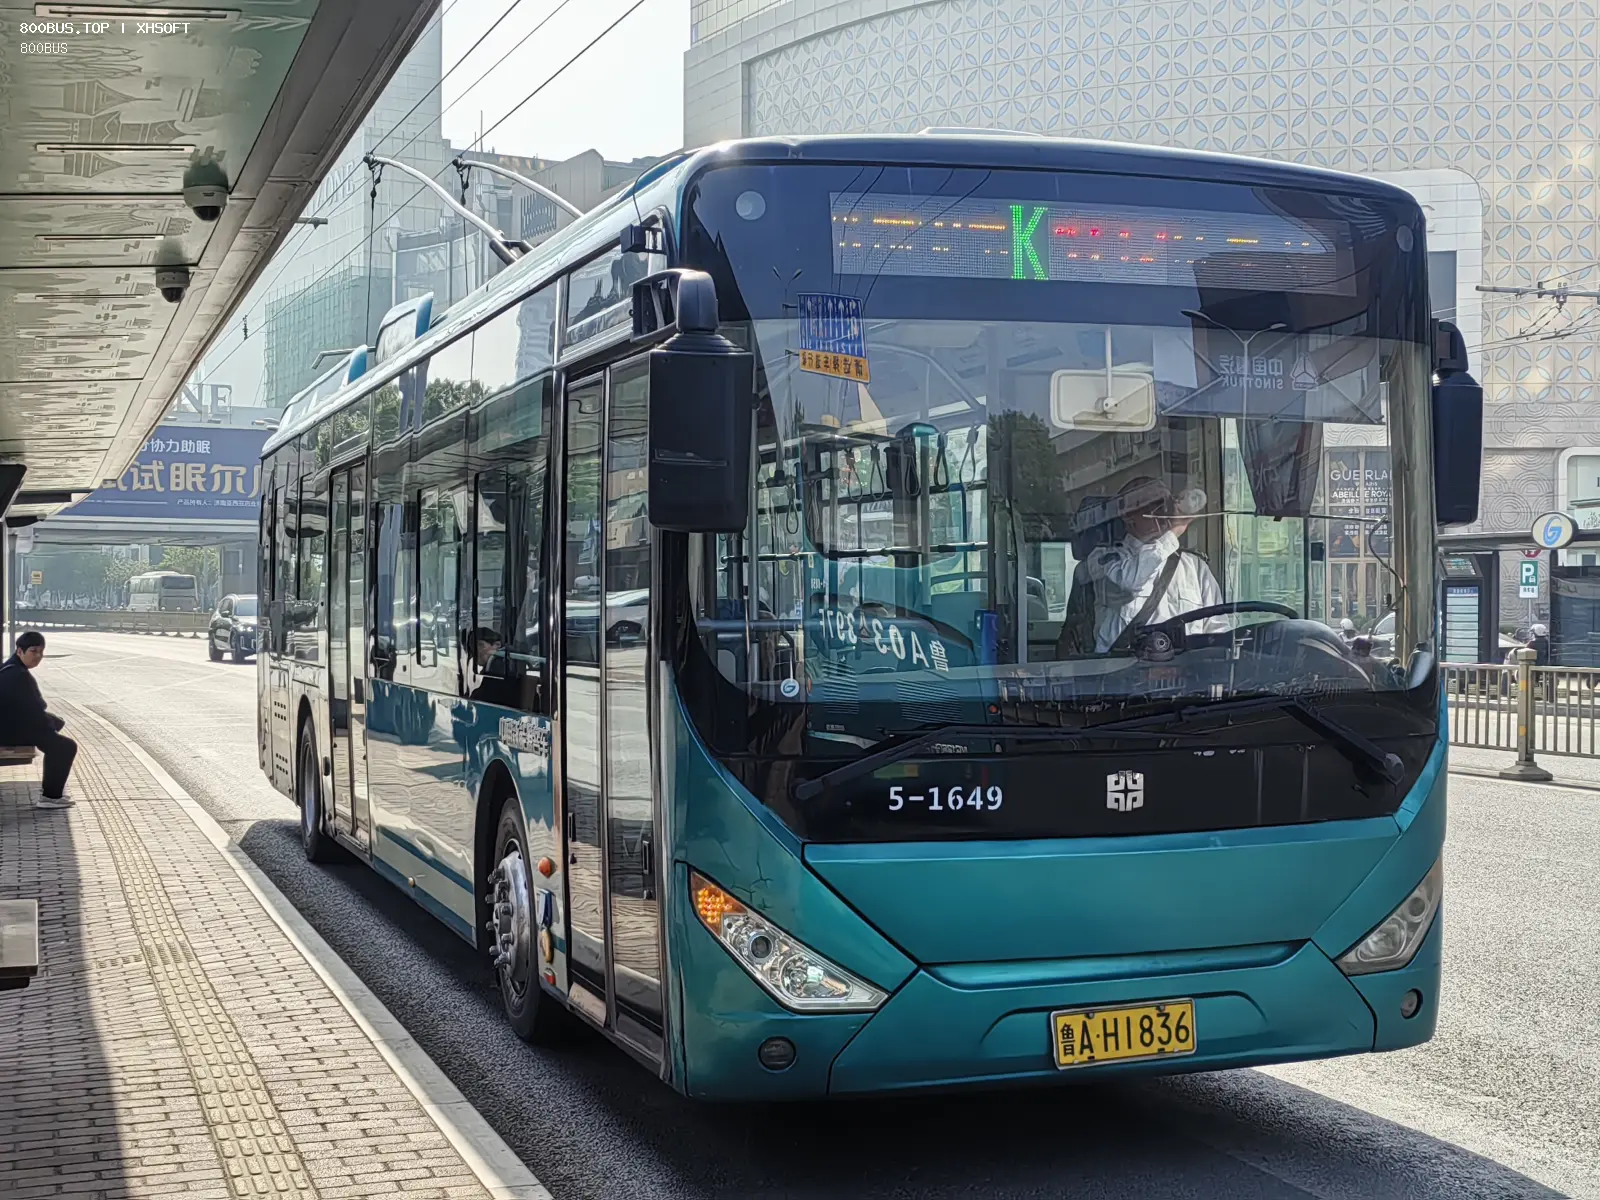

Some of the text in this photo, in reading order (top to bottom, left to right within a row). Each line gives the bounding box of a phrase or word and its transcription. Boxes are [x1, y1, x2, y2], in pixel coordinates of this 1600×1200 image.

[1009, 204, 1049, 281] K
[1522, 563, 1535, 584] P
[888, 786, 1003, 811] 5-1649
